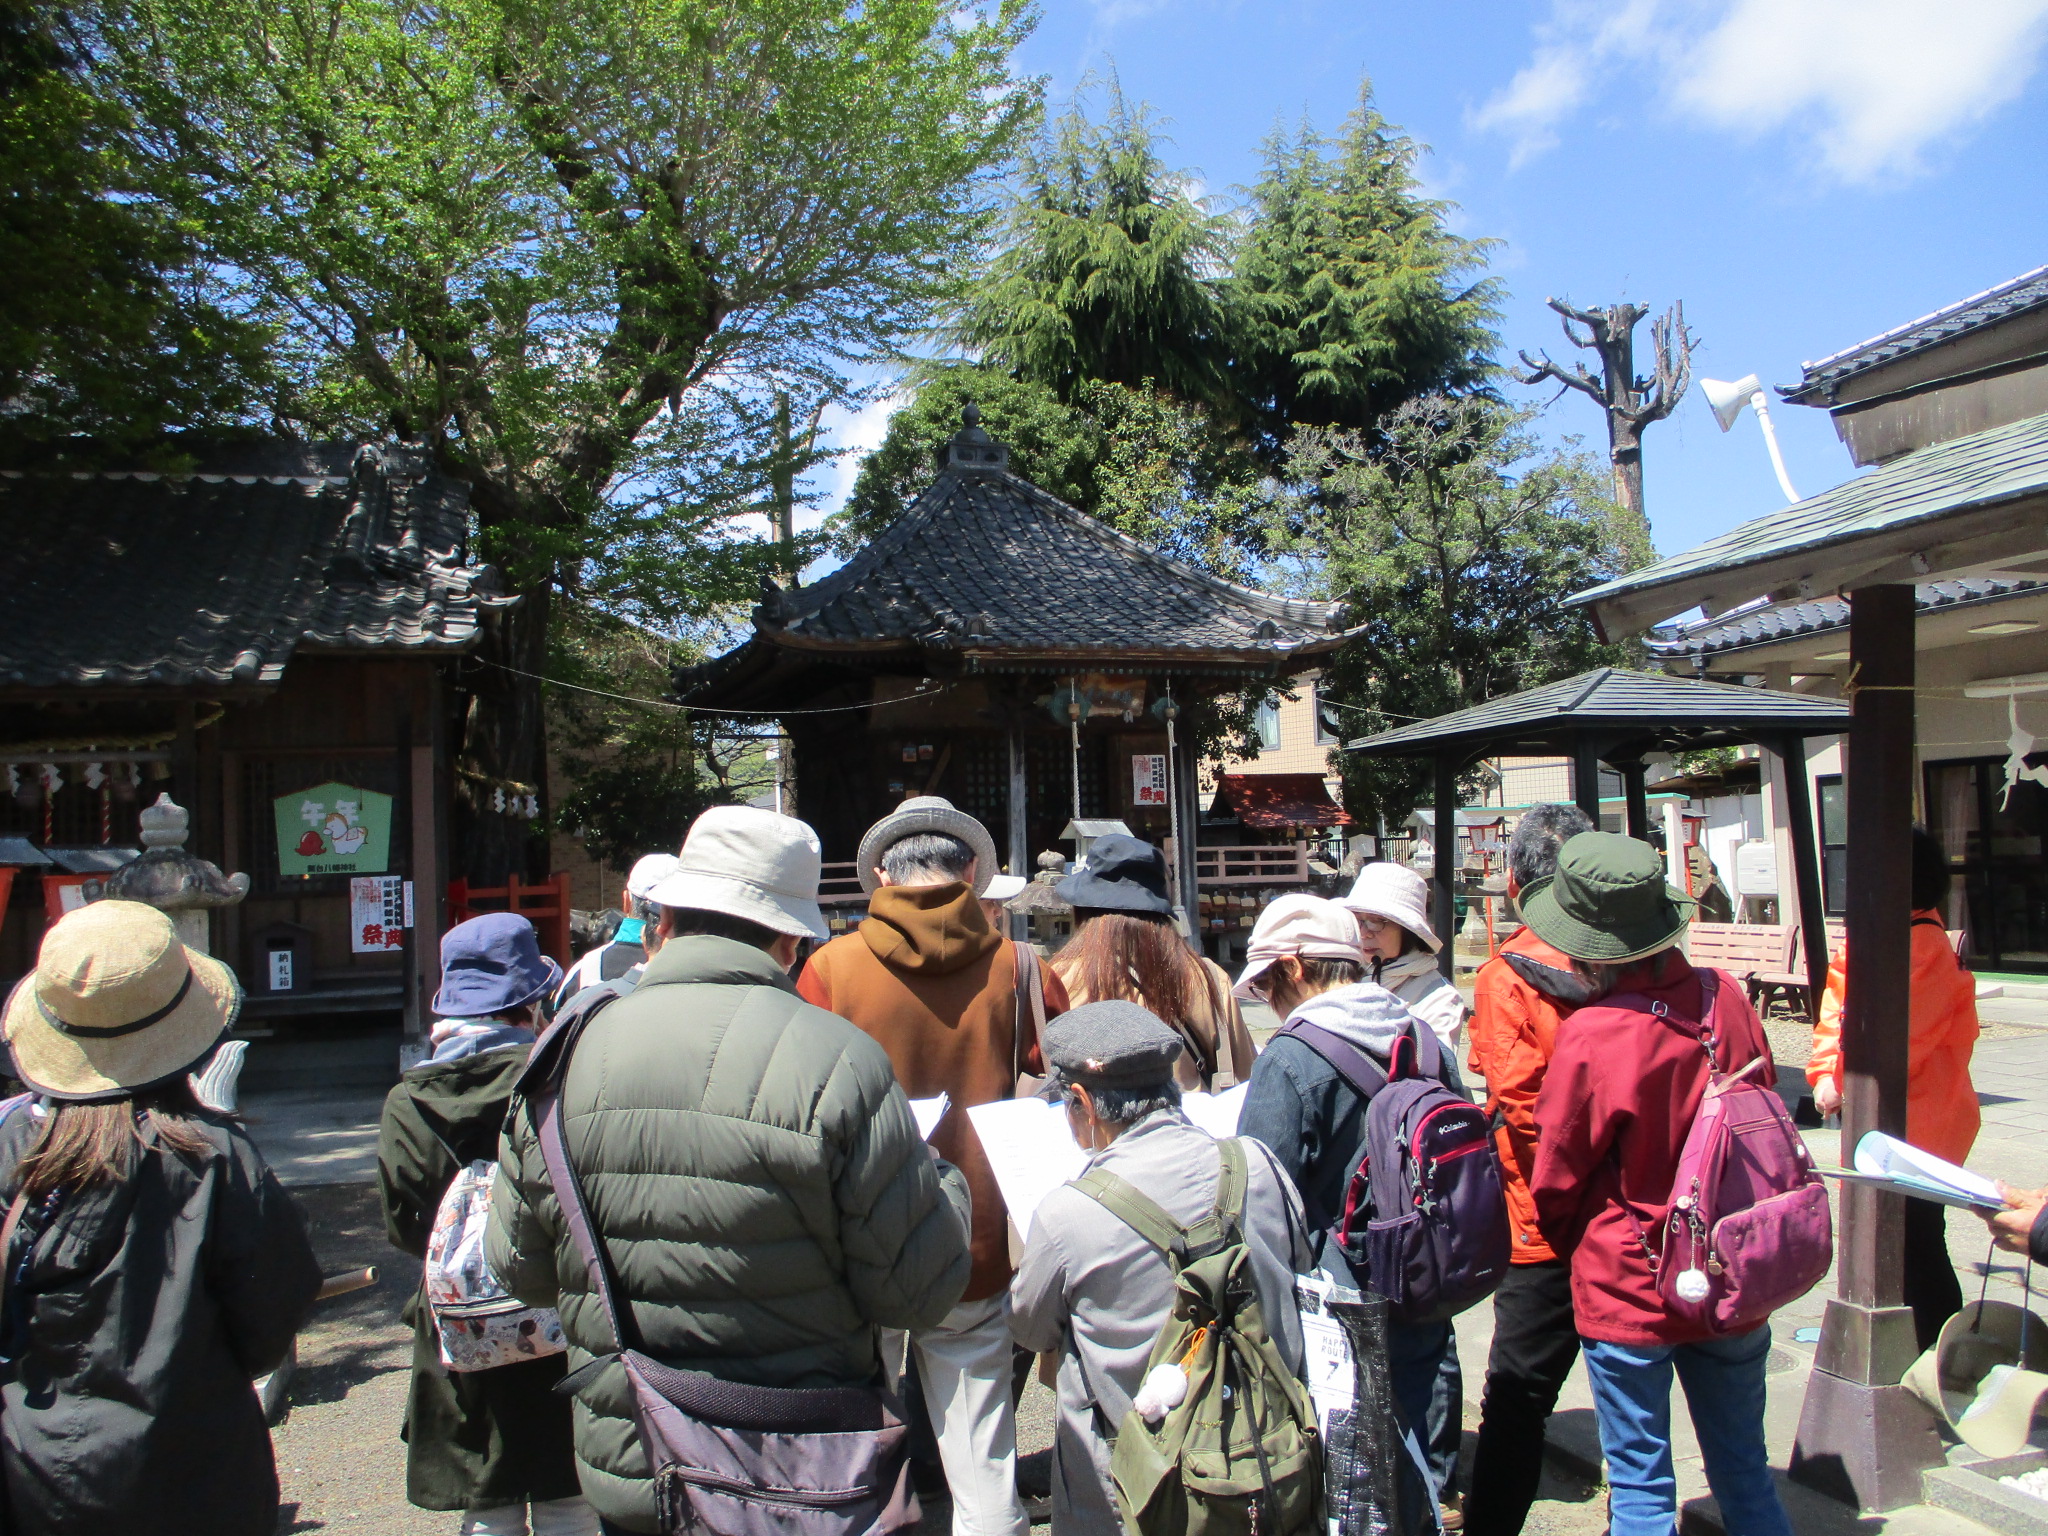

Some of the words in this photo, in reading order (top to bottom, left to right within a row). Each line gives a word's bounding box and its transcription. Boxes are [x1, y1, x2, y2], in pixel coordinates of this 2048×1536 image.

[301, 800, 359, 827] 午年
[1442, 1121, 1468, 1133] Columbia
[1321, 1345, 1348, 1359] ROUTE
[1326, 1360, 1340, 1381] 7
